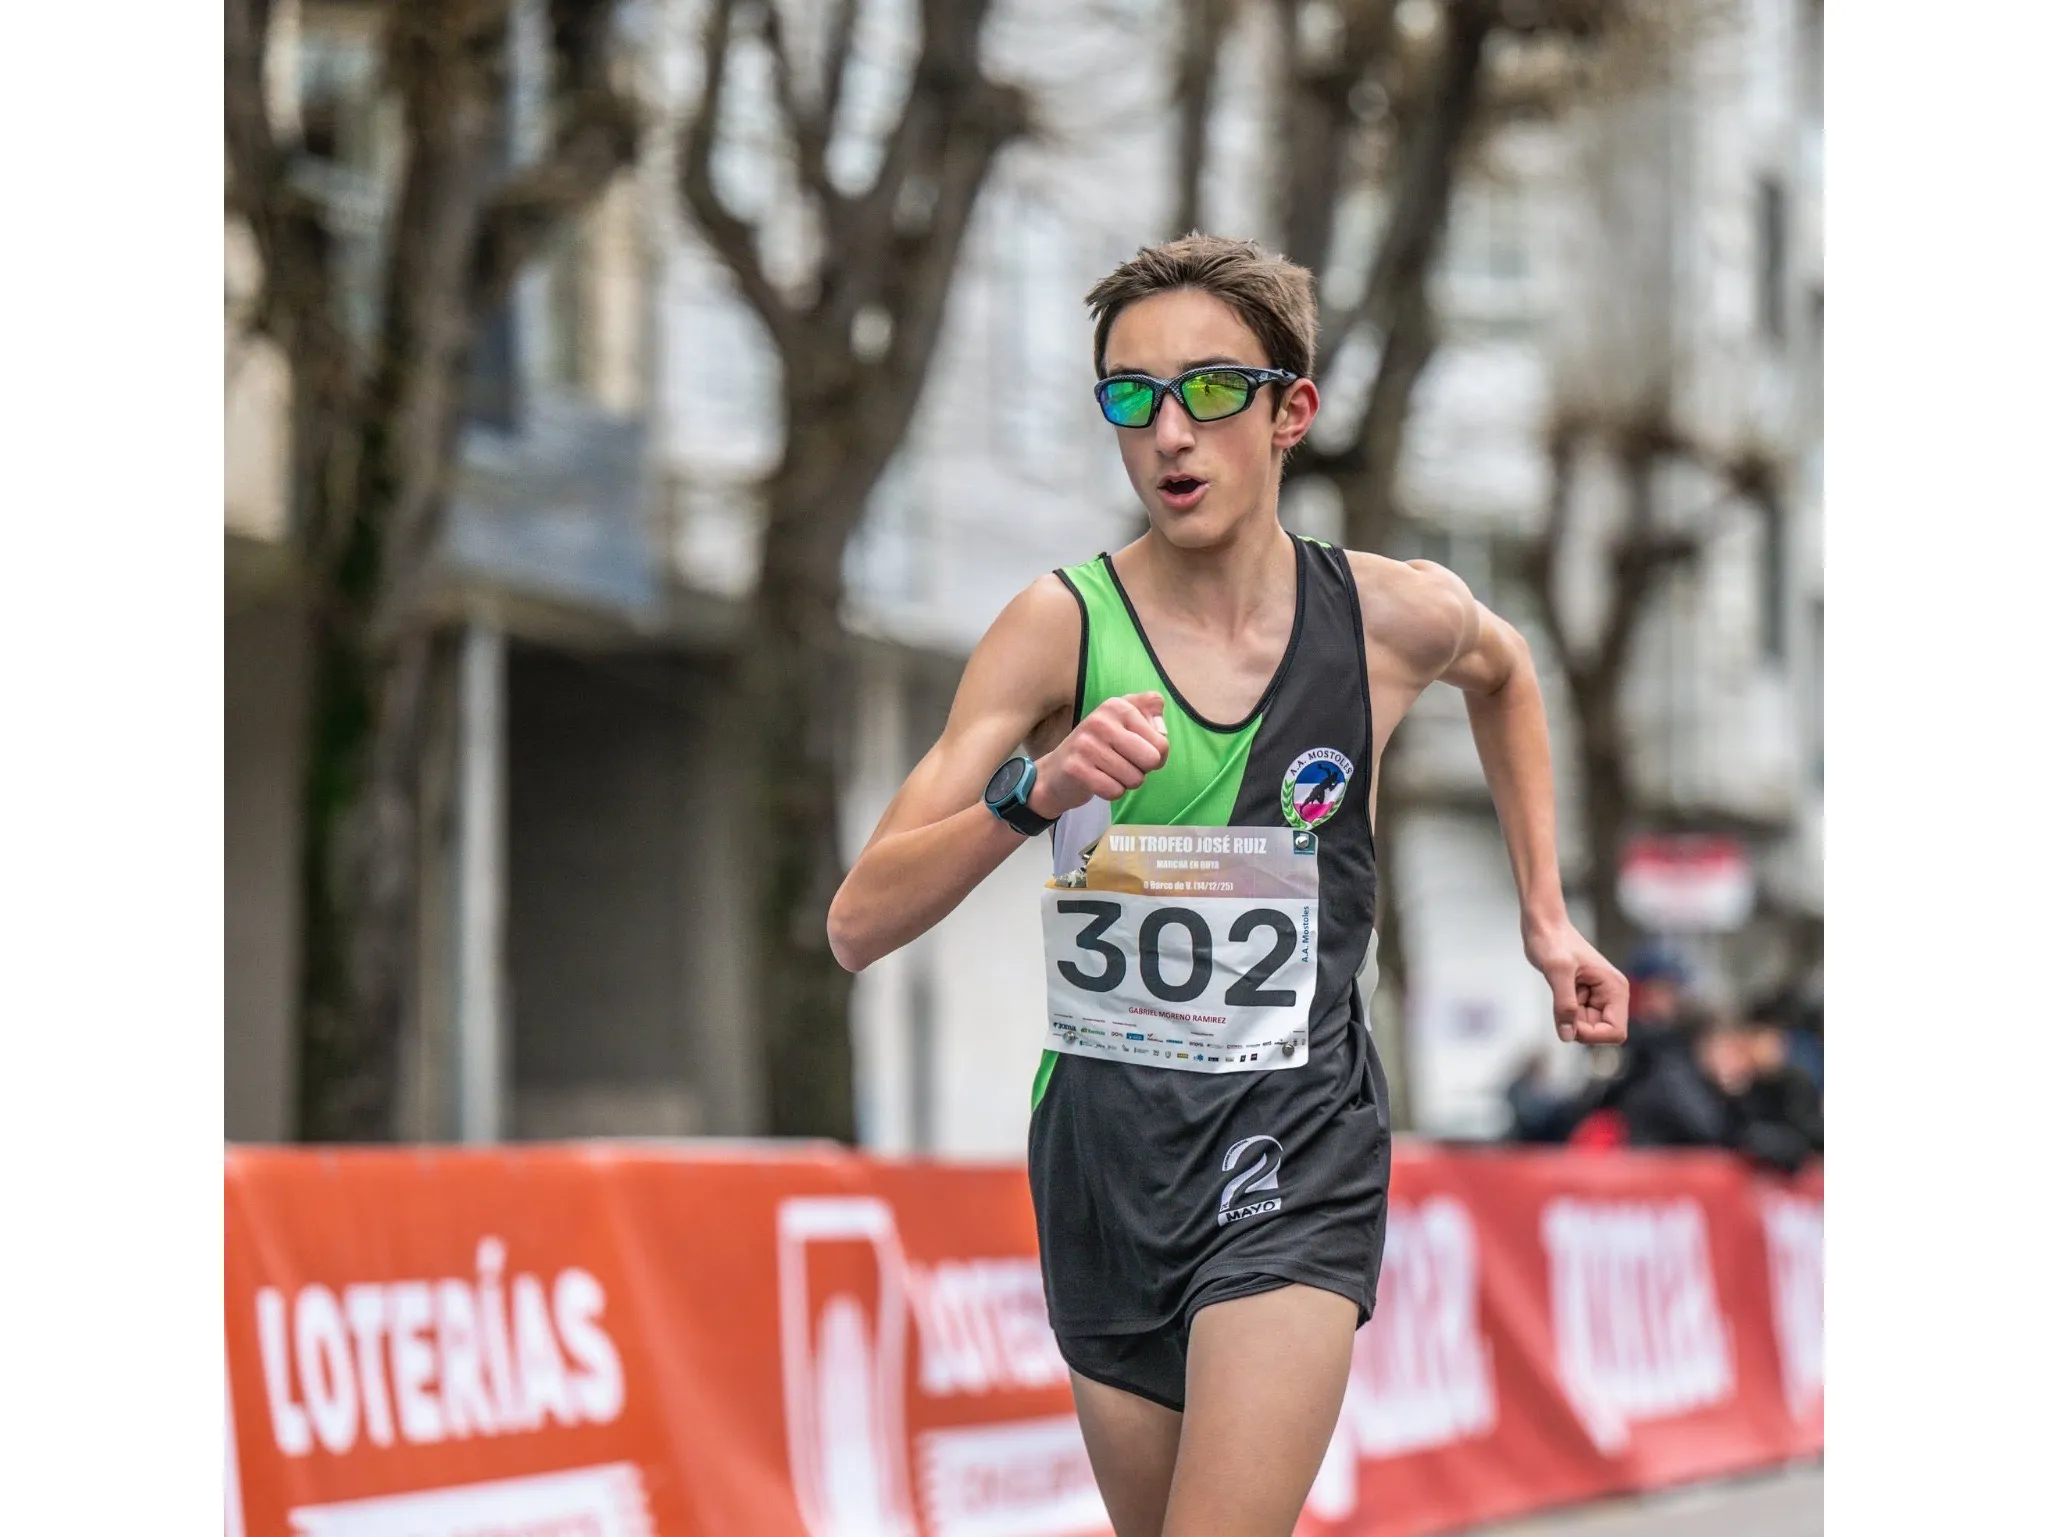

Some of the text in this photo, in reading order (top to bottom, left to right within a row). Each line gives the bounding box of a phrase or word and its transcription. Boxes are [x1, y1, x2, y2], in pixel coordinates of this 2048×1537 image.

[1290, 749, 1353, 776] A.A. MOSTOLES
[1109, 834, 1267, 854] VIII TROFEO JOSÉ RUIZ
[1174, 881, 1184, 890] de
[1301, 906, 1310, 963] A.A. Mostoles
[1057, 900, 1297, 1007] 302
[1128, 1006, 1226, 1025] GABRIEL MORENO RAMIREZ
[1226, 1201, 1275, 1222] MAYO
[255, 1235, 625, 1457] LOTERÍAS
